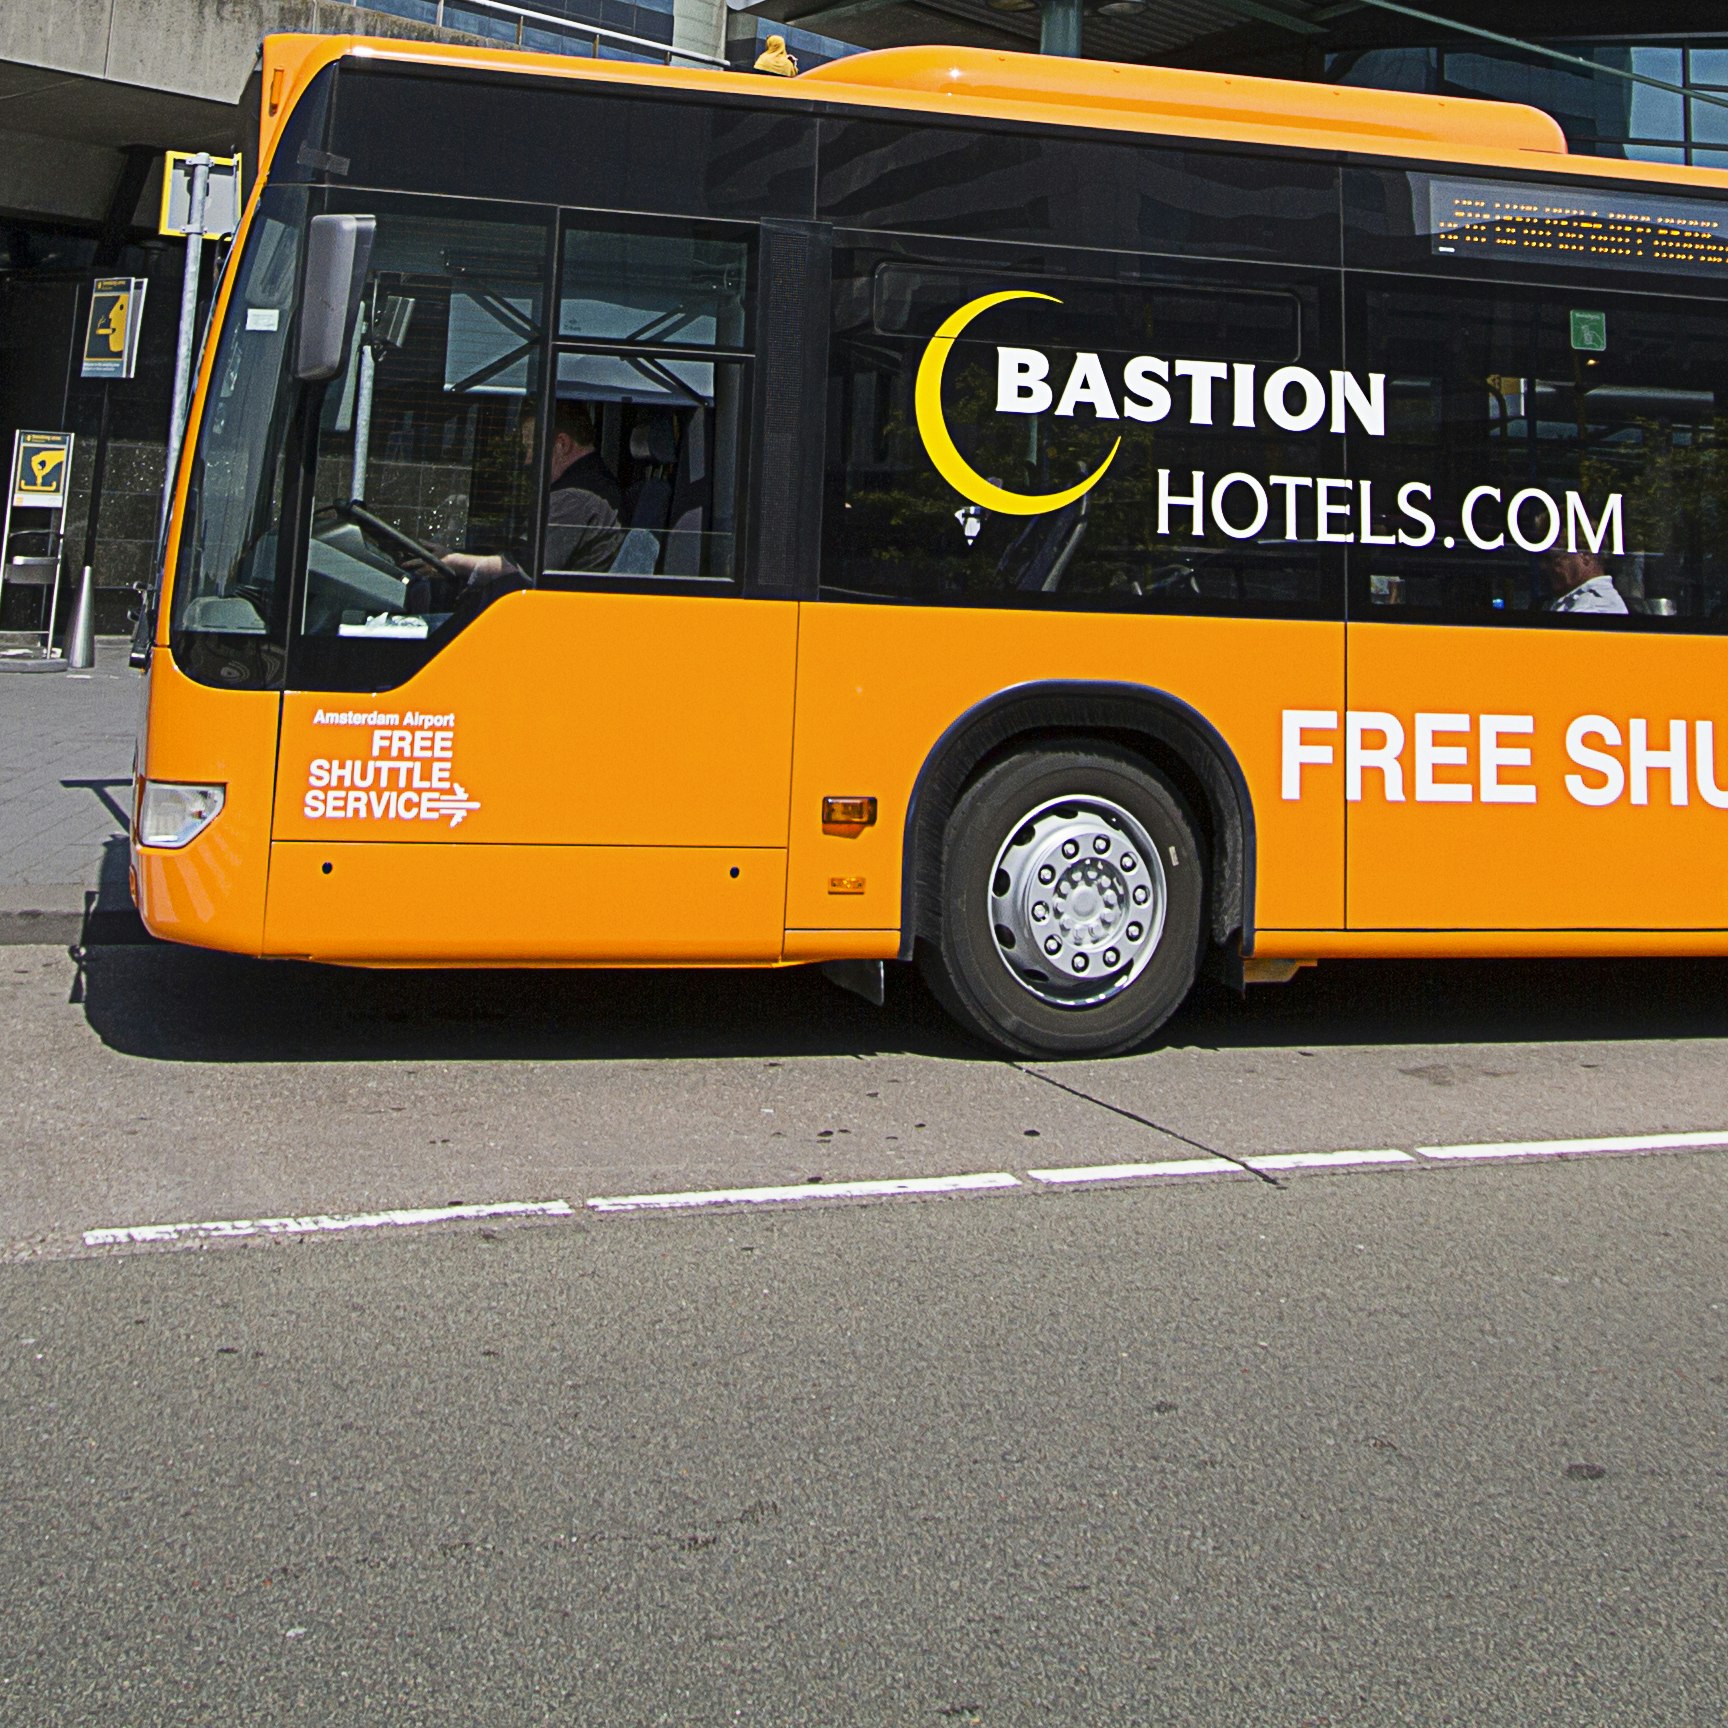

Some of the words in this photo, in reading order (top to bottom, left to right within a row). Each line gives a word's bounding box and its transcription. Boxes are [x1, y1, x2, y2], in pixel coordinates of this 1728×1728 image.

[995, 345, 1386, 437] BASTION
[1156, 466, 1626, 555] HOTELS.COM
[313, 709, 399, 726] Amsterdam
[402, 712, 455, 729] Airport
[372, 730, 454, 758] FREE
[1281, 709, 1537, 804] FREE
[308, 758, 452, 789] SHUTTLE
[303, 790, 441, 820] SERVICE
